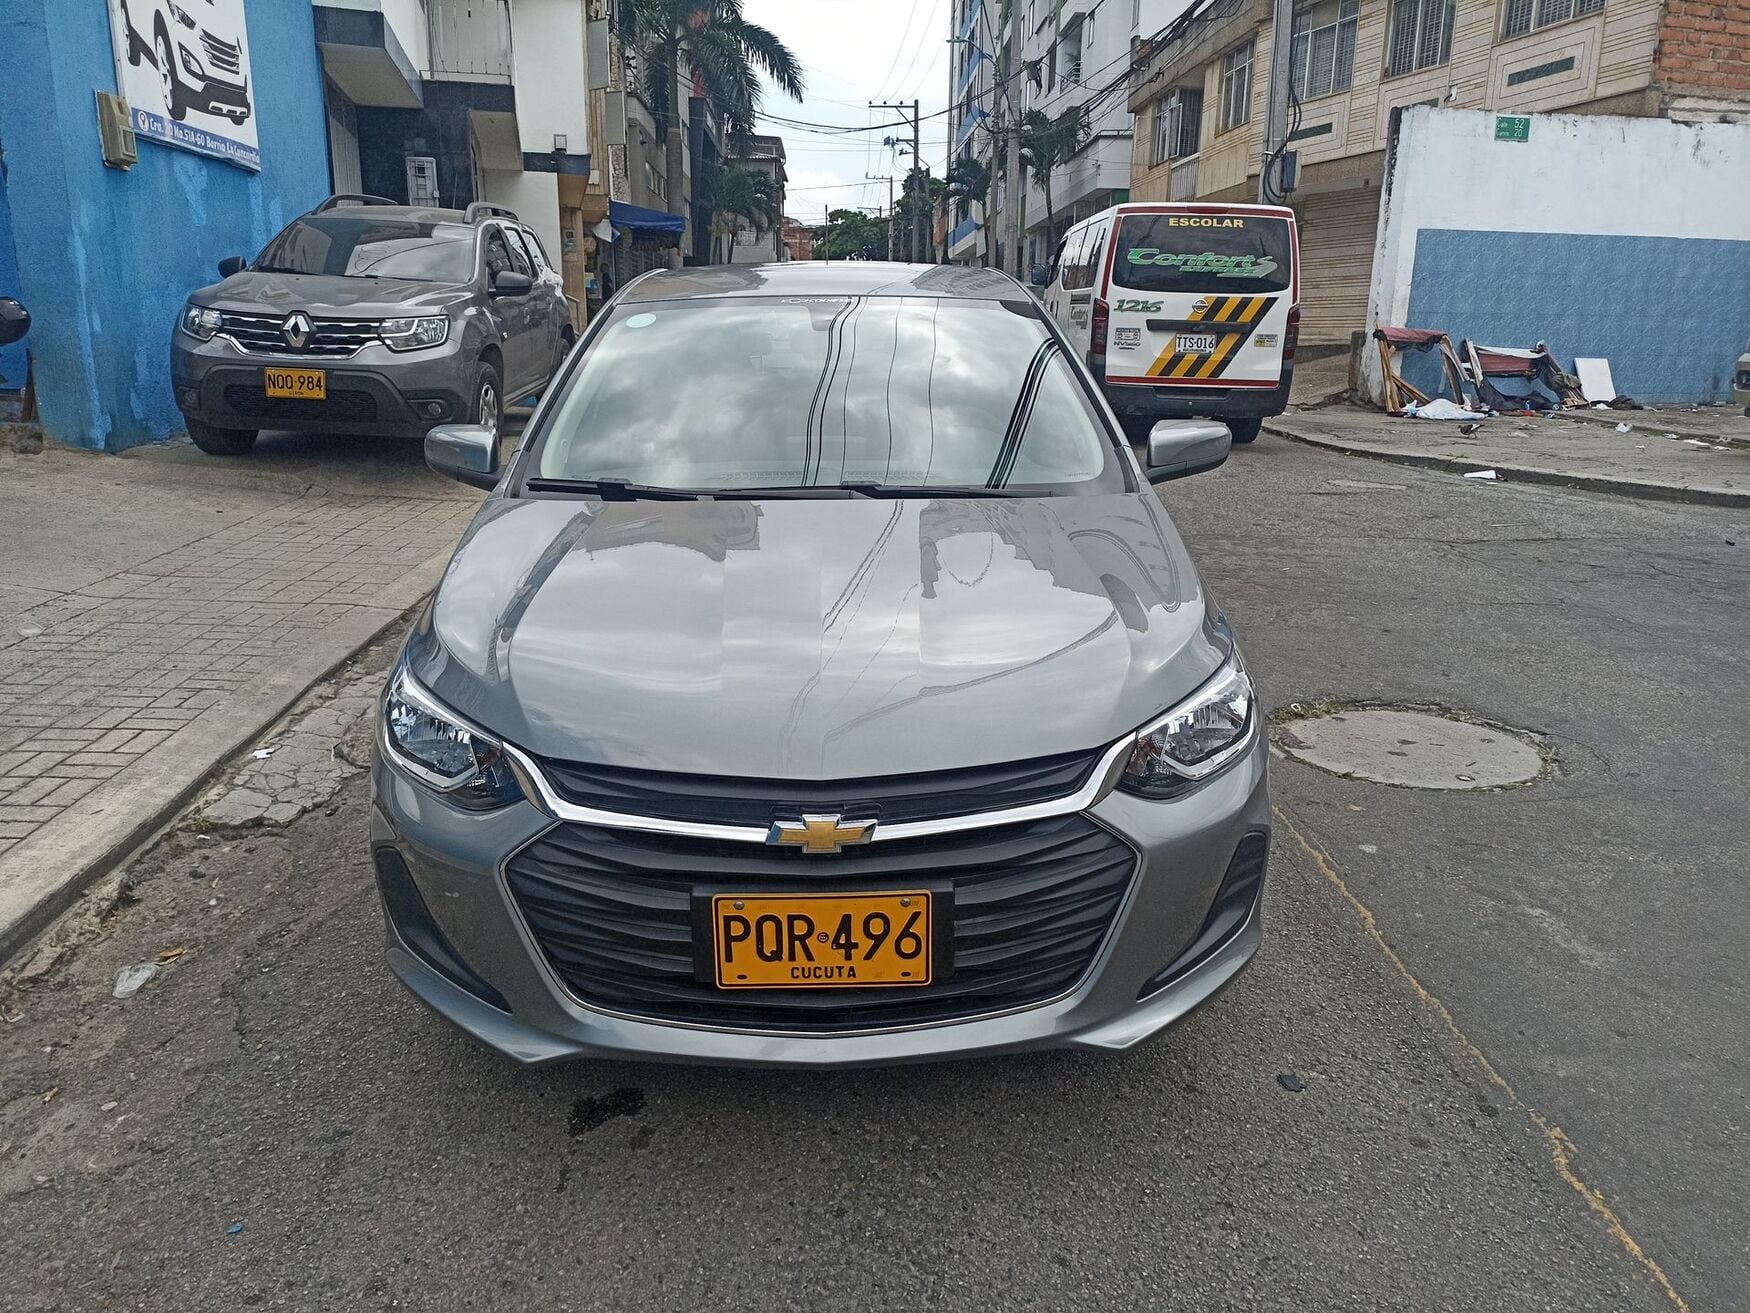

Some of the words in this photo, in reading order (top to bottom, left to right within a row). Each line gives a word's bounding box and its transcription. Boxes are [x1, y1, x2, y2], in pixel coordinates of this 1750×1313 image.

[1514, 118, 1525, 129] 52
[149, 117, 163, 132] Cra.
[206, 135, 226, 153] Barrio
[1514, 128, 1523, 137] 20
[1168, 217, 1244, 228] ESCOLAR
[1113, 299, 1164, 313] 1216
[791, 966, 857, 979] CUCUTA
